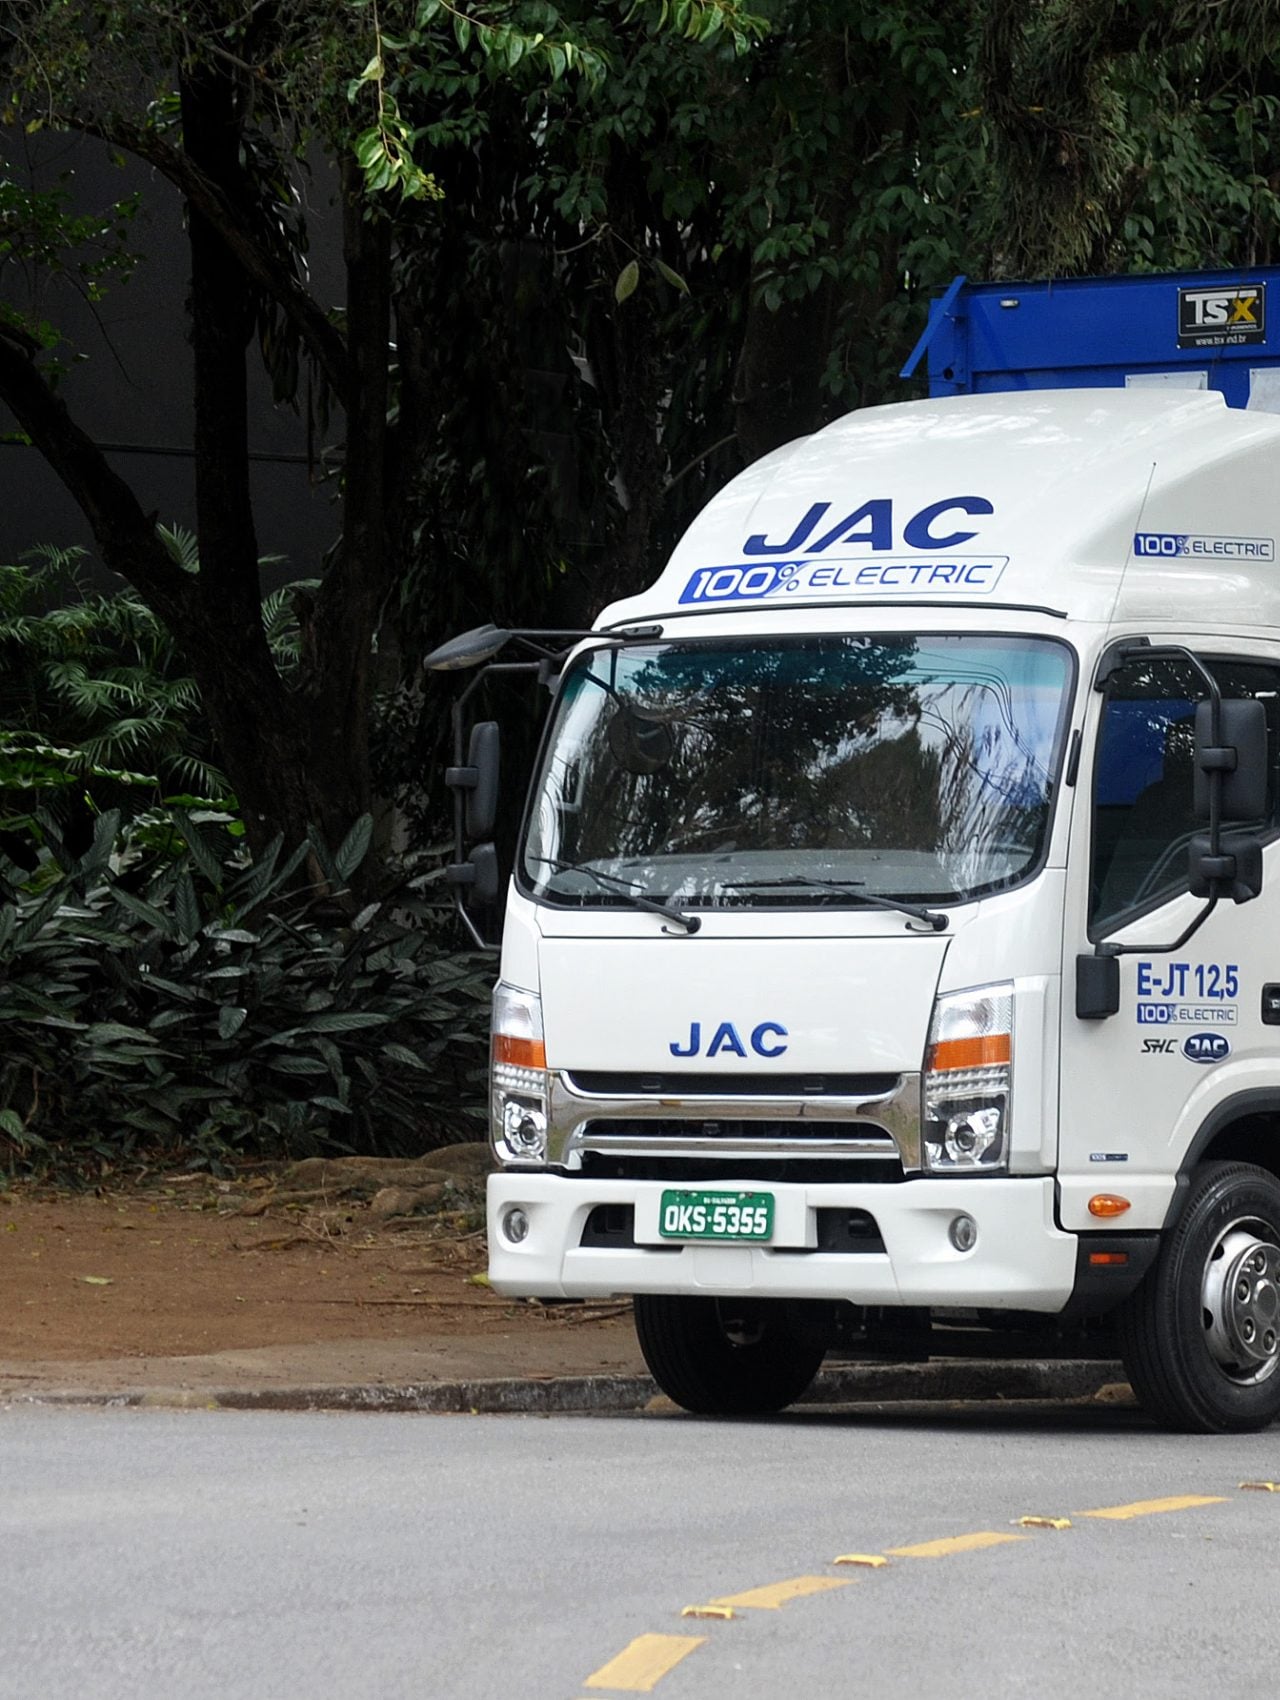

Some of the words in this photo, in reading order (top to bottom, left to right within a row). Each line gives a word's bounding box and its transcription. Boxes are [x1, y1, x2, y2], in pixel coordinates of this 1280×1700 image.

[1185, 289, 1258, 325] TSX
[743, 496, 994, 555] JAC
[1138, 536, 1190, 554] 100%
[1192, 541, 1269, 556] ELECTRIC
[692, 562, 804, 599] 100%
[808, 564, 993, 587] ELECTRIC
[1137, 962, 1190, 996] E-JT
[1195, 964, 1238, 1001] 12,5
[1140, 1004, 1178, 1022] 100%
[1180, 1008, 1234, 1021] ELECTRIC
[669, 1022, 788, 1058] JAC
[1188, 1038, 1225, 1056] JAC
